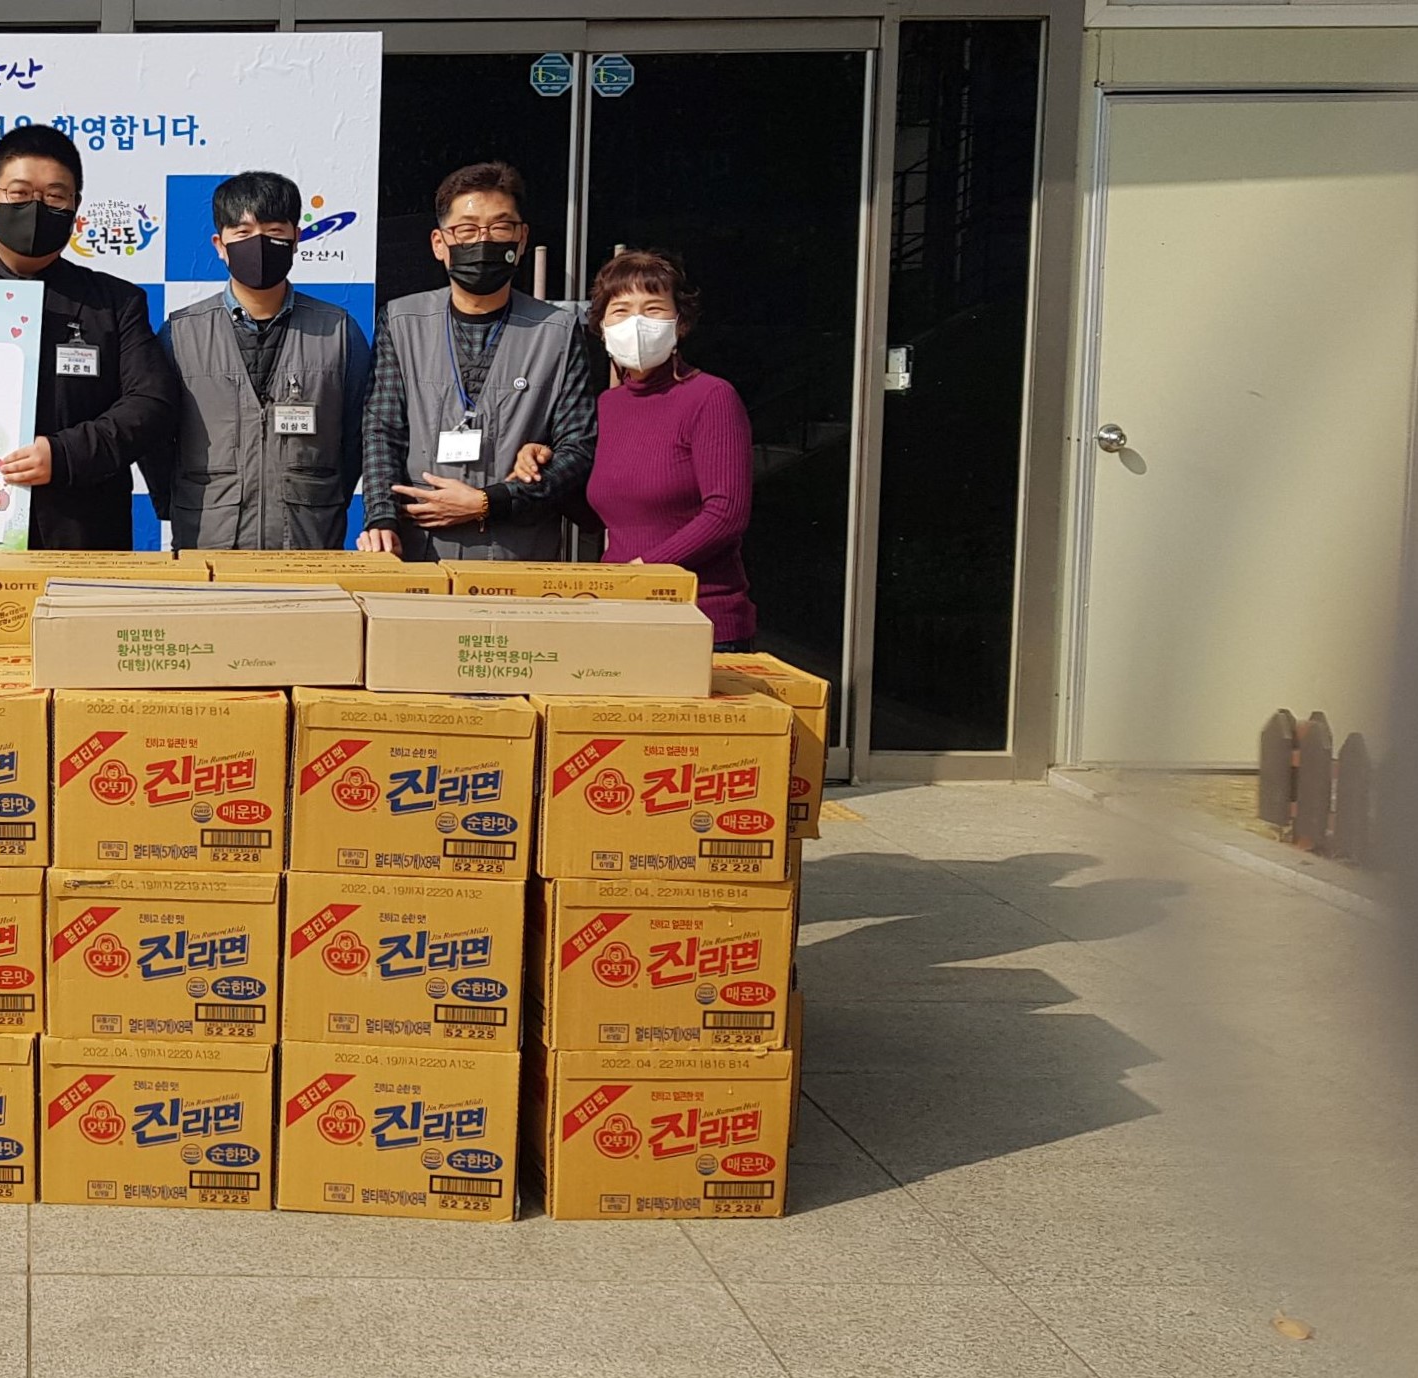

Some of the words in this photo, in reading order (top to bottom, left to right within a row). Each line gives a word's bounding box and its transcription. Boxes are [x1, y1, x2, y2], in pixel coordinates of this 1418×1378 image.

[86, 227, 138, 255] 원곡동
[300, 250, 344, 262] 안산시
[117, 629, 165, 642] 매일편한
[458, 635, 509, 649] 매일편한
[586, 669, 621, 677] Defense
[99, 779, 129, 794] 오뚜기
[143, 754, 253, 807] 진라면
[641, 762, 756, 816] 진라면
[341, 787, 372, 801] 오뚜기
[386, 765, 500, 816] 진라면
[595, 788, 626, 803] 오뚜기
[222, 804, 267, 822] 매운맛
[466, 815, 513, 833] 순한맛
[722, 813, 770, 832] 매운맛
[0, 844, 25, 854] 225
[710, 863, 728, 872] 52
[733, 862, 760, 872] 228
[93, 954, 123, 967] 오뚜기
[136, 930, 247, 981] 진라면
[376, 931, 489, 981] 진라면
[646, 935, 759, 989] 진라면
[601, 962, 632, 976] 오뚜기
[216, 979, 261, 997] 순한맛
[456, 981, 502, 999] 순한맛
[725, 985, 771, 1004] 매운맛
[446, 1029, 463, 1038] 52
[469, 1030, 495, 1039] 225
[131, 1097, 241, 1148] 진라면
[371, 1101, 484, 1152] 진라면
[648, 1106, 759, 1160] 진라면
[210, 1147, 255, 1164] 순한맛
[452, 1153, 497, 1170] 순한맛
[726, 1156, 771, 1174] 매운맛
